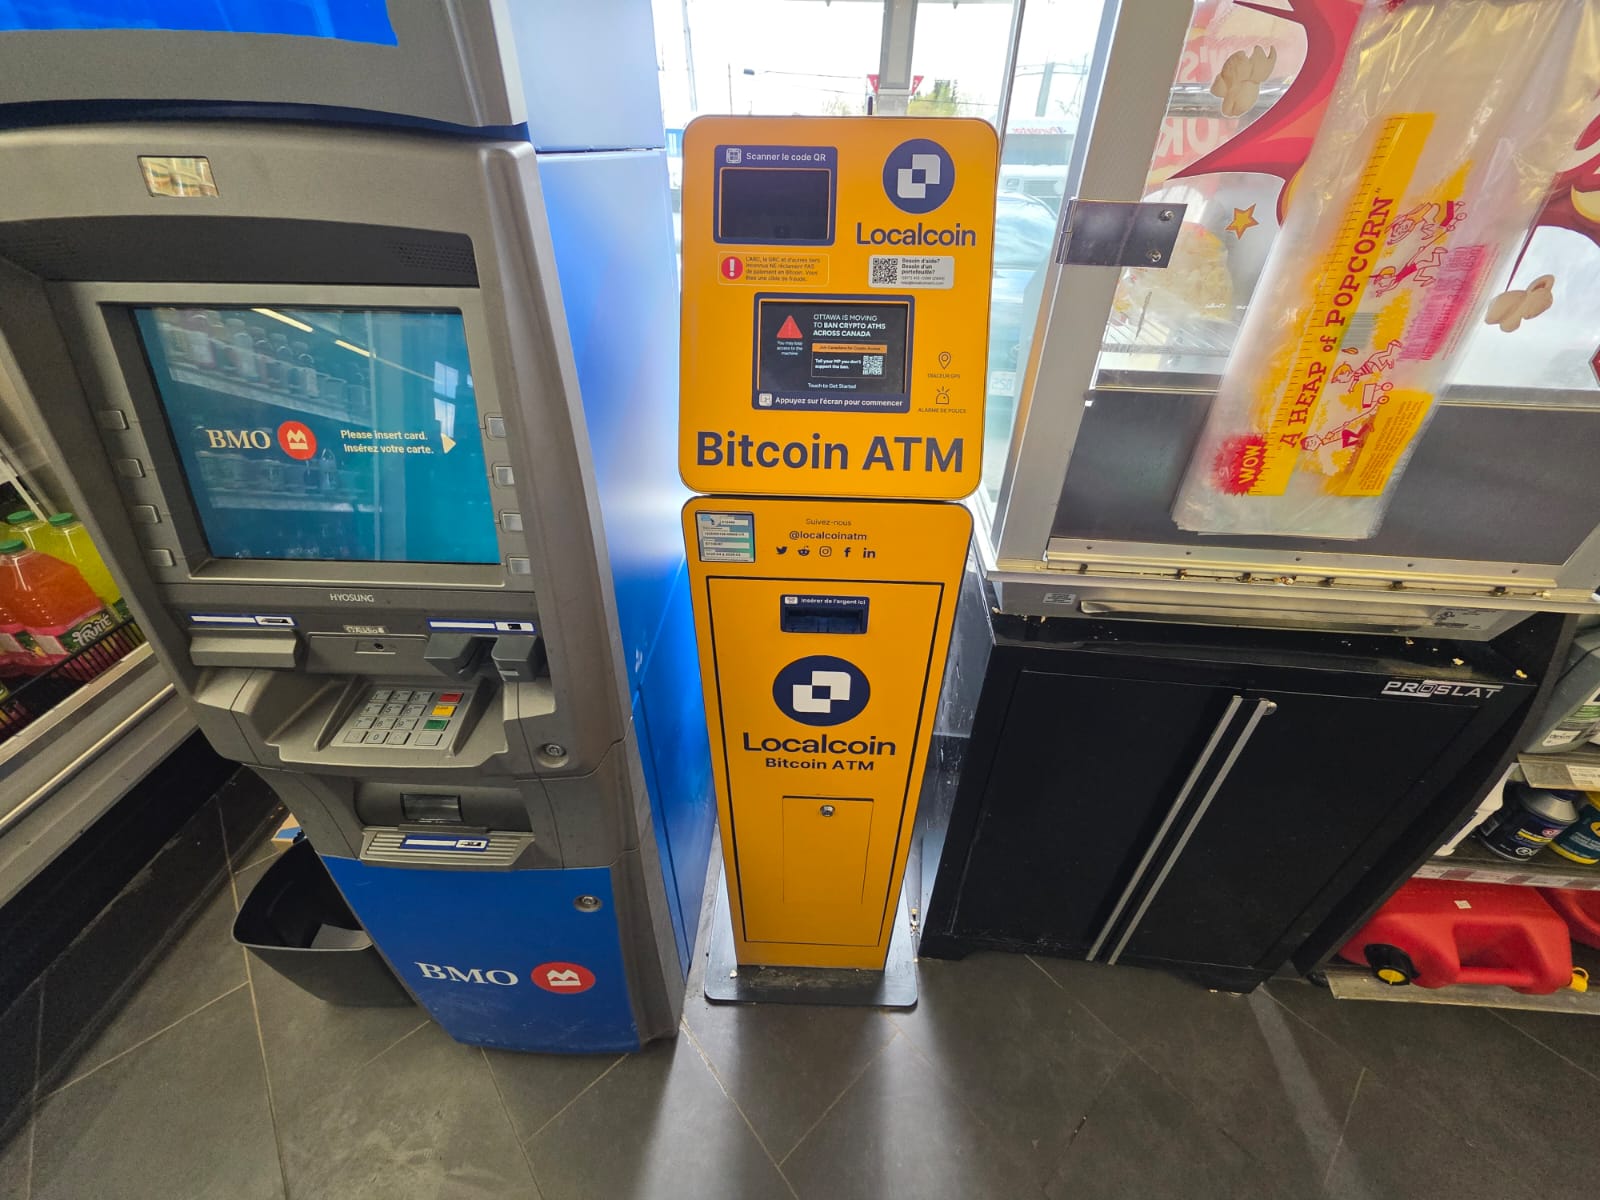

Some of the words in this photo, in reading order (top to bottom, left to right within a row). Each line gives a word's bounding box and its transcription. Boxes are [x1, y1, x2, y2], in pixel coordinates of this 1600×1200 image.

[746, 152, 780, 160] Scanner
[791, 153, 812, 161] code
[814, 154, 826, 162] QR
[856, 222, 976, 247] Localcoin
[1288, 361, 1327, 426] HEAP
[1320, 335, 1338, 352] of
[776, 397, 805, 405] Appuyez
[206, 429, 272, 450] BMO
[340, 430, 373, 440] Please
[374, 430, 402, 440] insert
[404, 431, 428, 440] card.
[344, 443, 378, 453] Insérez
[380, 445, 404, 454] votre
[406, 445, 434, 454] carte.
[697, 430, 848, 470] Bitcoin
[862, 436, 964, 472] ATM
[1238, 444, 1261, 485] WOW
[806, 518, 852, 526] Suivez-nous
[789, 530, 867, 541] @localcoinatm
[330, 593, 374, 602] HYOSUNG
[1383, 681, 1500, 698] PROSLAT
[743, 732, 896, 755] Localcoin
[766, 758, 826, 769] Bitcoin
[832, 760, 874, 770] ATM
[414, 961, 519, 986] BMO
